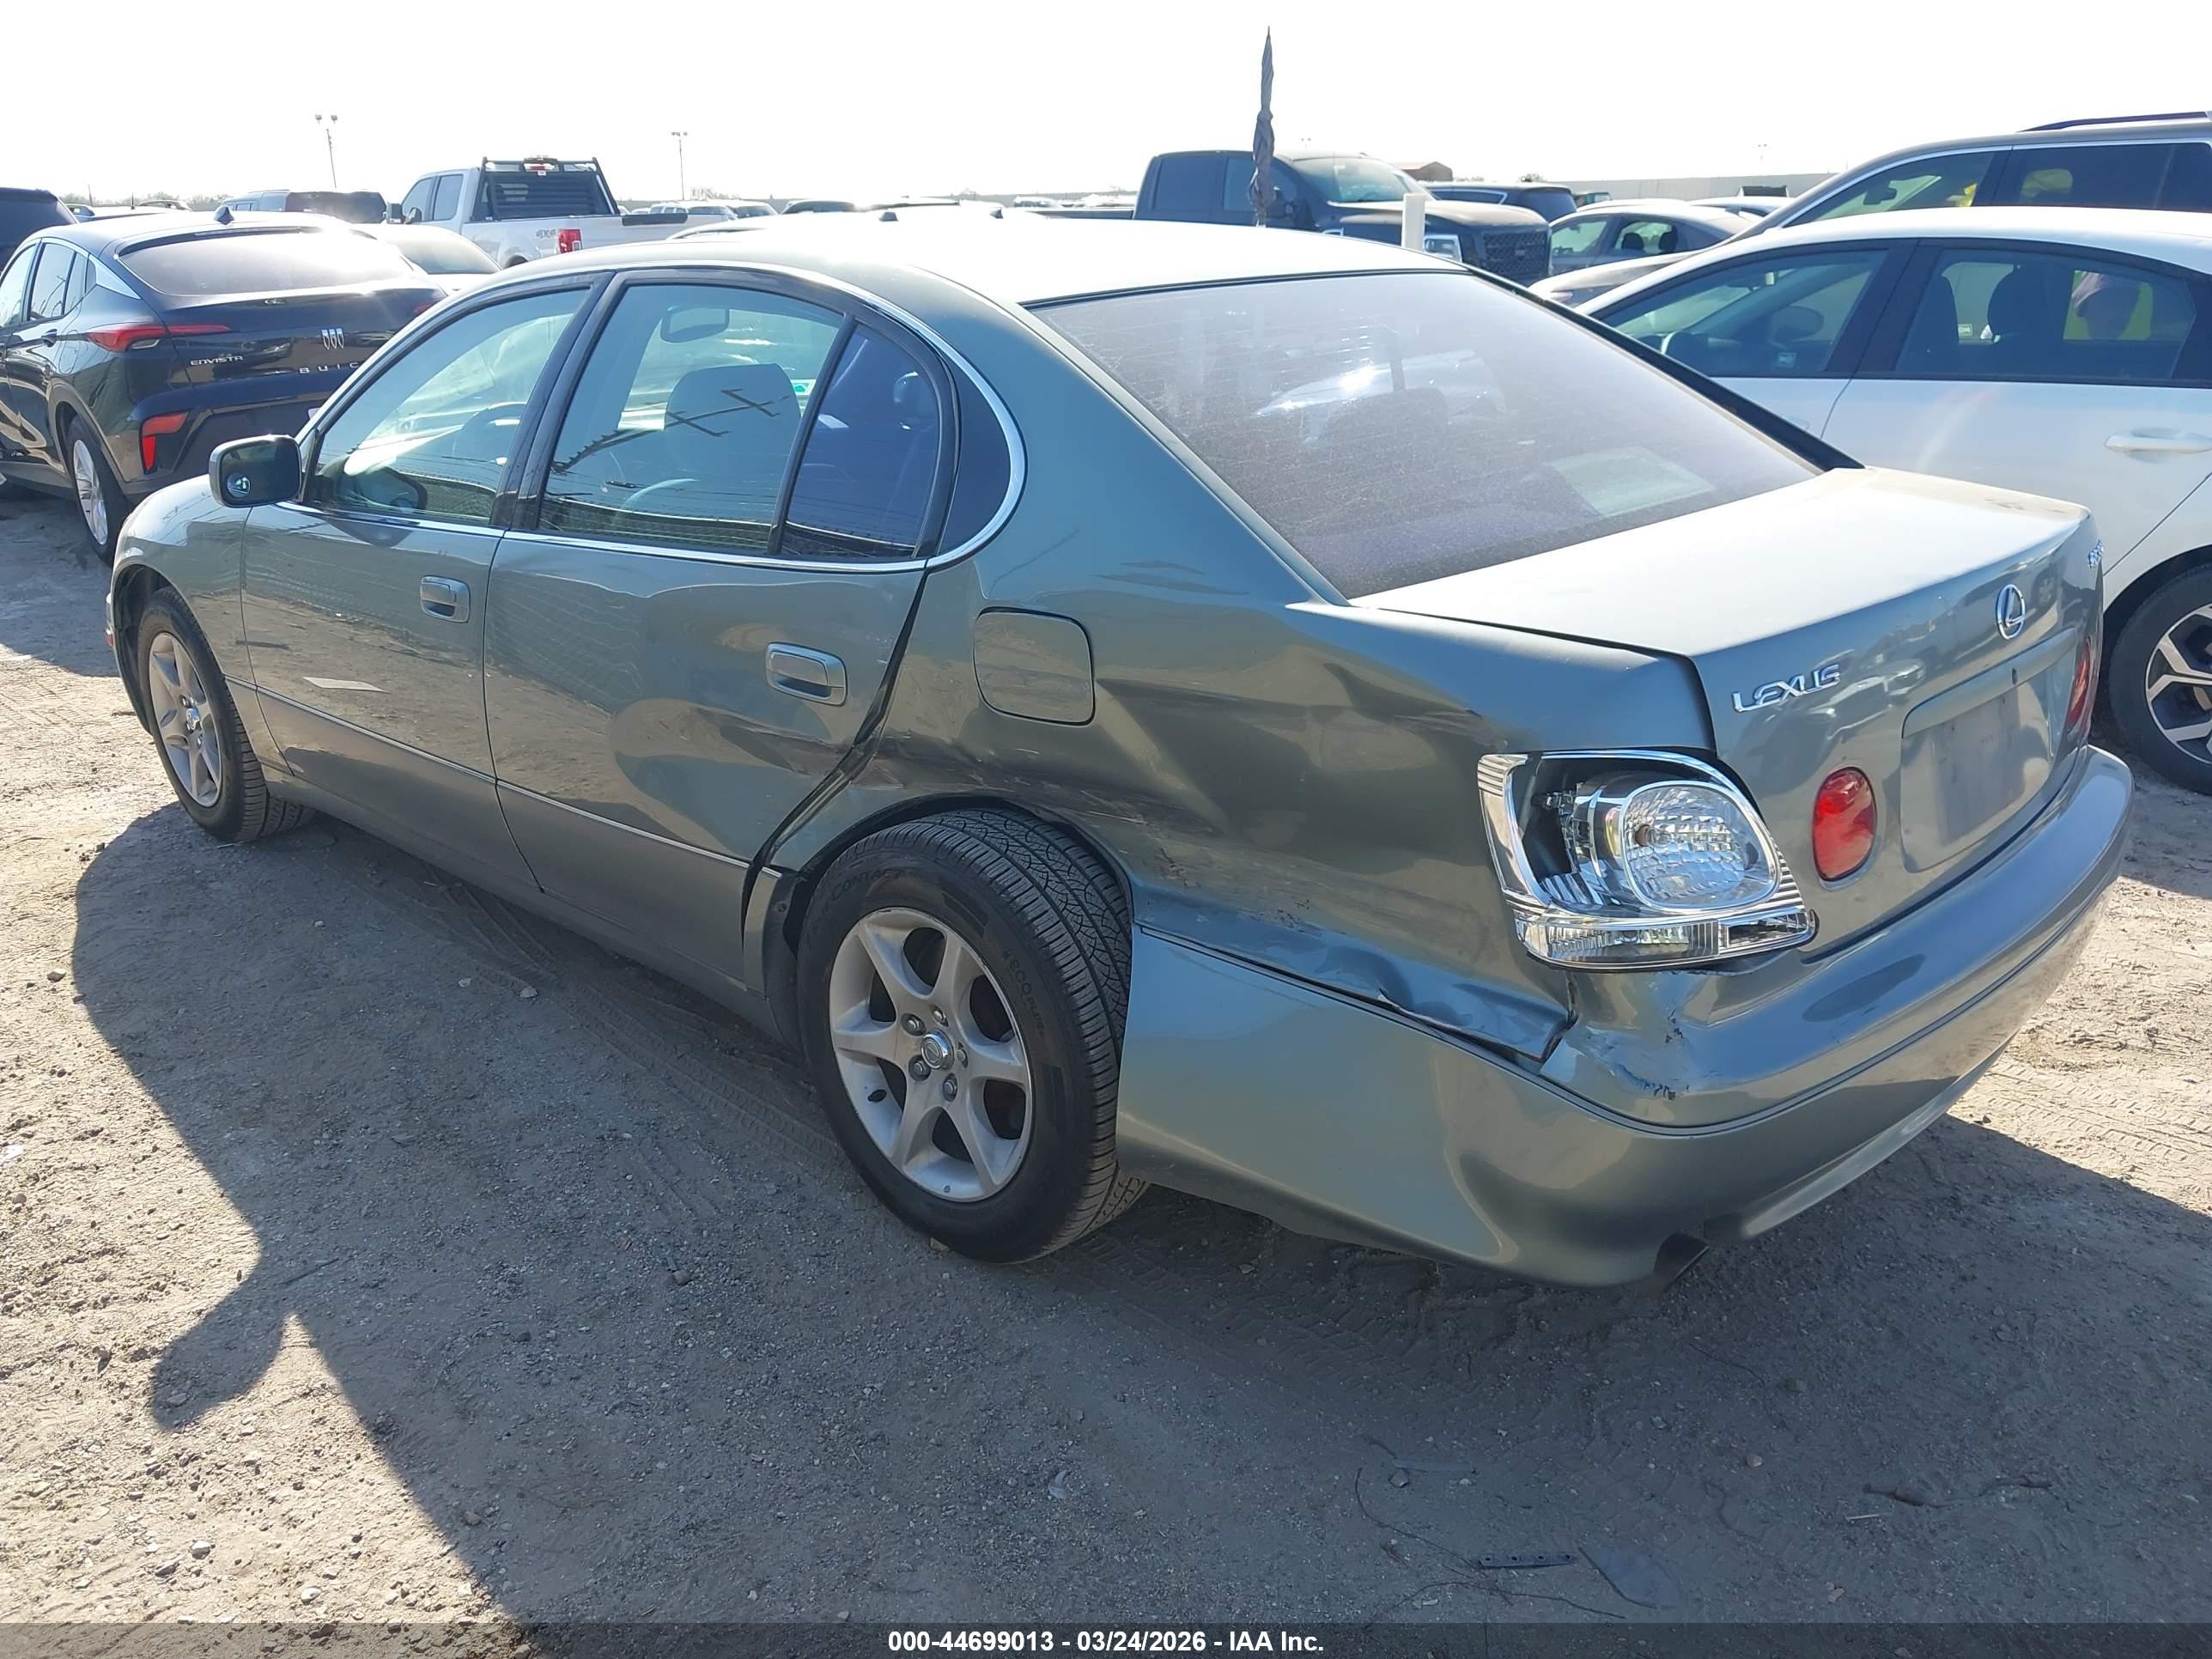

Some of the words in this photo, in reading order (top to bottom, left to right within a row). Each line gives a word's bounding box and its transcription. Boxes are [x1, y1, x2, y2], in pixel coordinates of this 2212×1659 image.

[191, 356, 243, 366] ENVISTA
[299, 362, 359, 374] BUIC
[1731, 664, 1841, 713] LEXUS
